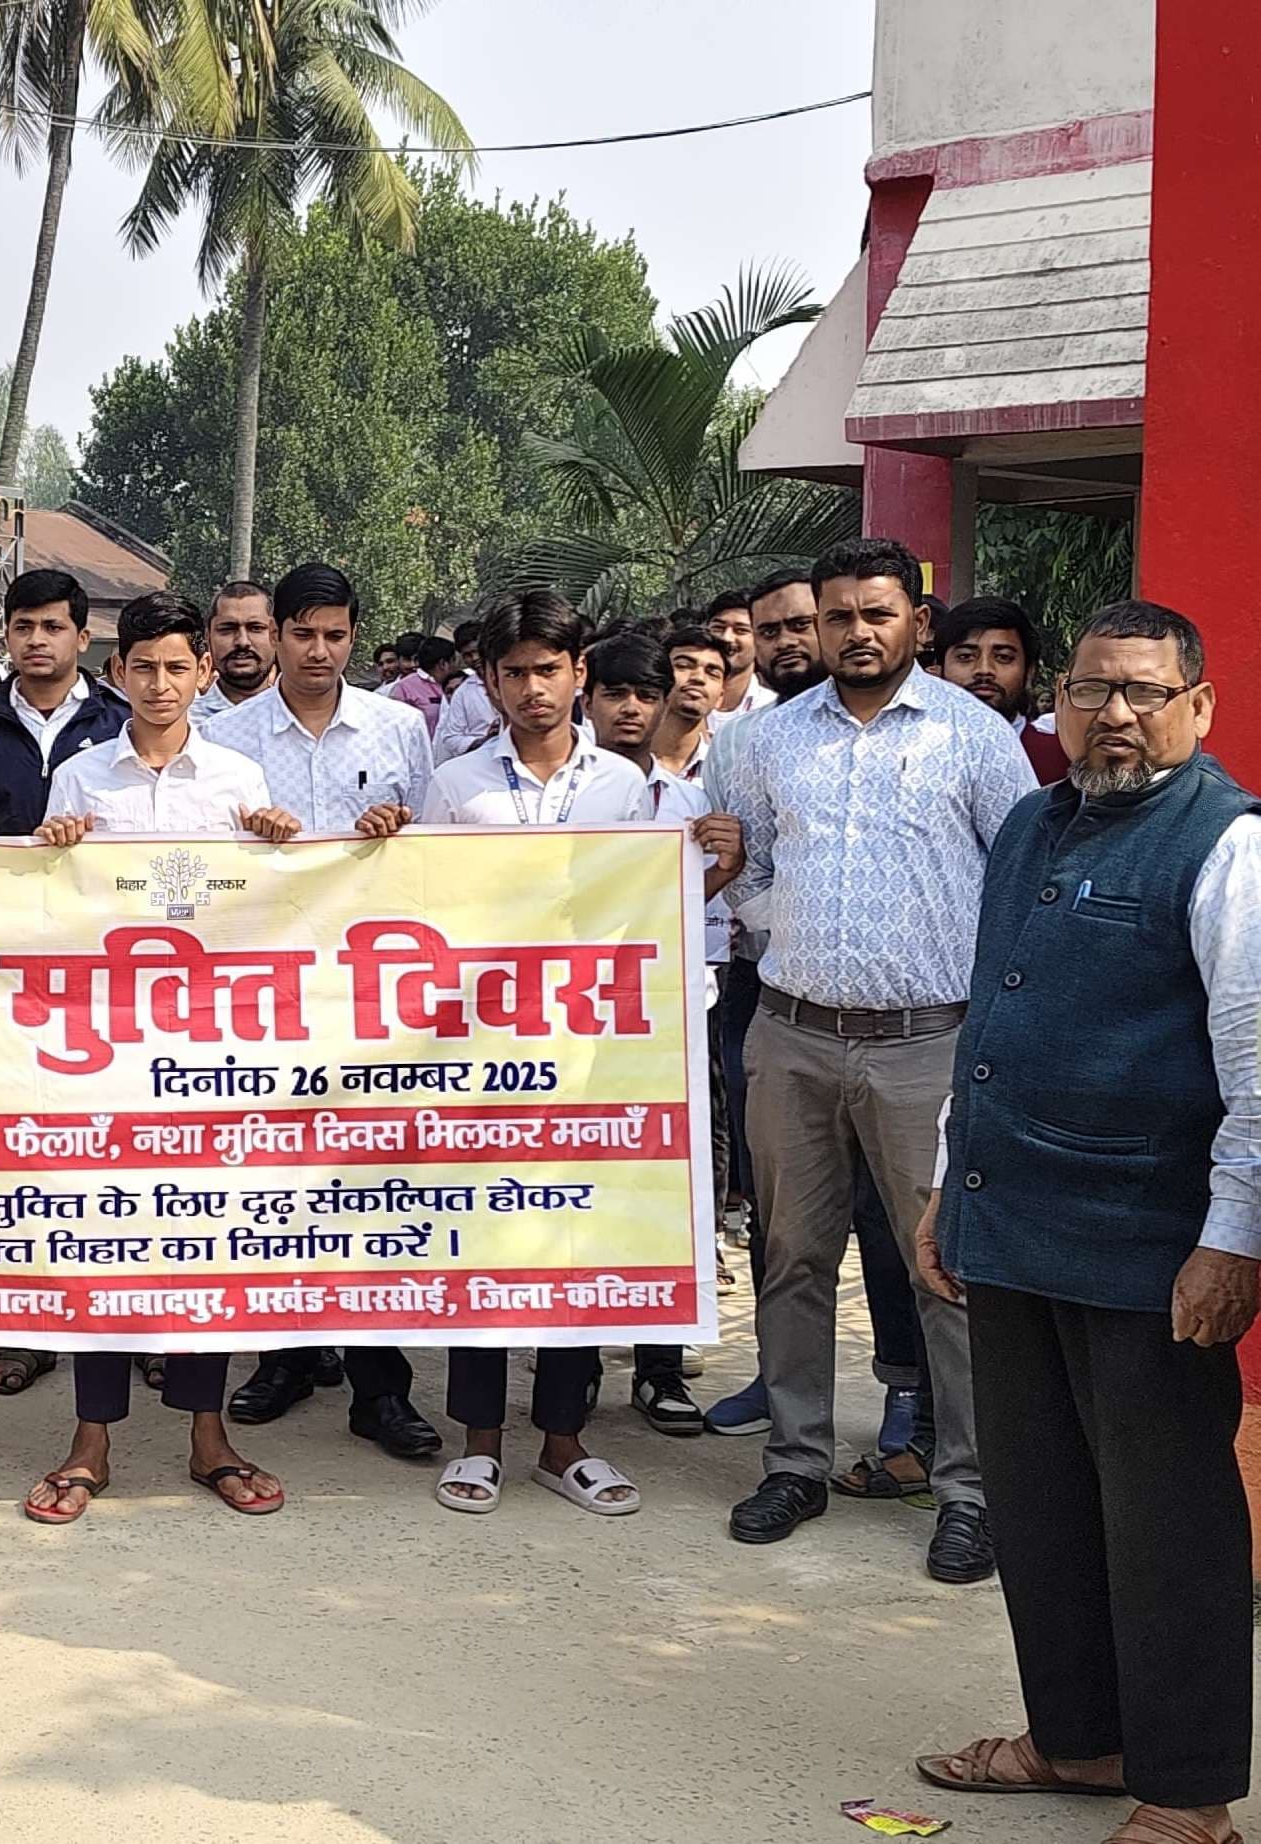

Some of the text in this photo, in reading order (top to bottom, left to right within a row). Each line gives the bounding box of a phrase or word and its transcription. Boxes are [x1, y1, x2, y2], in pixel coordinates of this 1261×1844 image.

[116, 876, 247, 891] बिहार सरकार
[339, 921, 658, 1040] दिवस
[150, 1055, 558, 1097] दिनांक 26 नवम्बर 2025
[4, 1113, 121, 1160] फैलाएँ,
[132, 1124, 206, 1155] नशा
[213, 1113, 307, 1165] मुक्ति
[313, 1112, 408, 1152] दिवस
[415, 1109, 547, 1150] मिलकर
[550, 1106, 649, 1149] मनाएँ
[97, 1185, 140, 1218] के
[152, 1183, 229, 1218] लिए
[240, 1190, 296, 1225] दृढ़
[306, 1178, 476, 1214] संकल्पित
[486, 1177, 594, 1212] होकर
[47, 1230, 152, 1264] बिहार
[160, 1236, 217, 1262] का
[227, 1225, 353, 1260] निर्माण
[364, 1222, 432, 1258] करें
[88, 1286, 235, 1323] आबादपुर,
[245, 1277, 458, 1317] प्रखंड-बारसोई,
[467, 1274, 677, 1312] जिला-कटिहार
